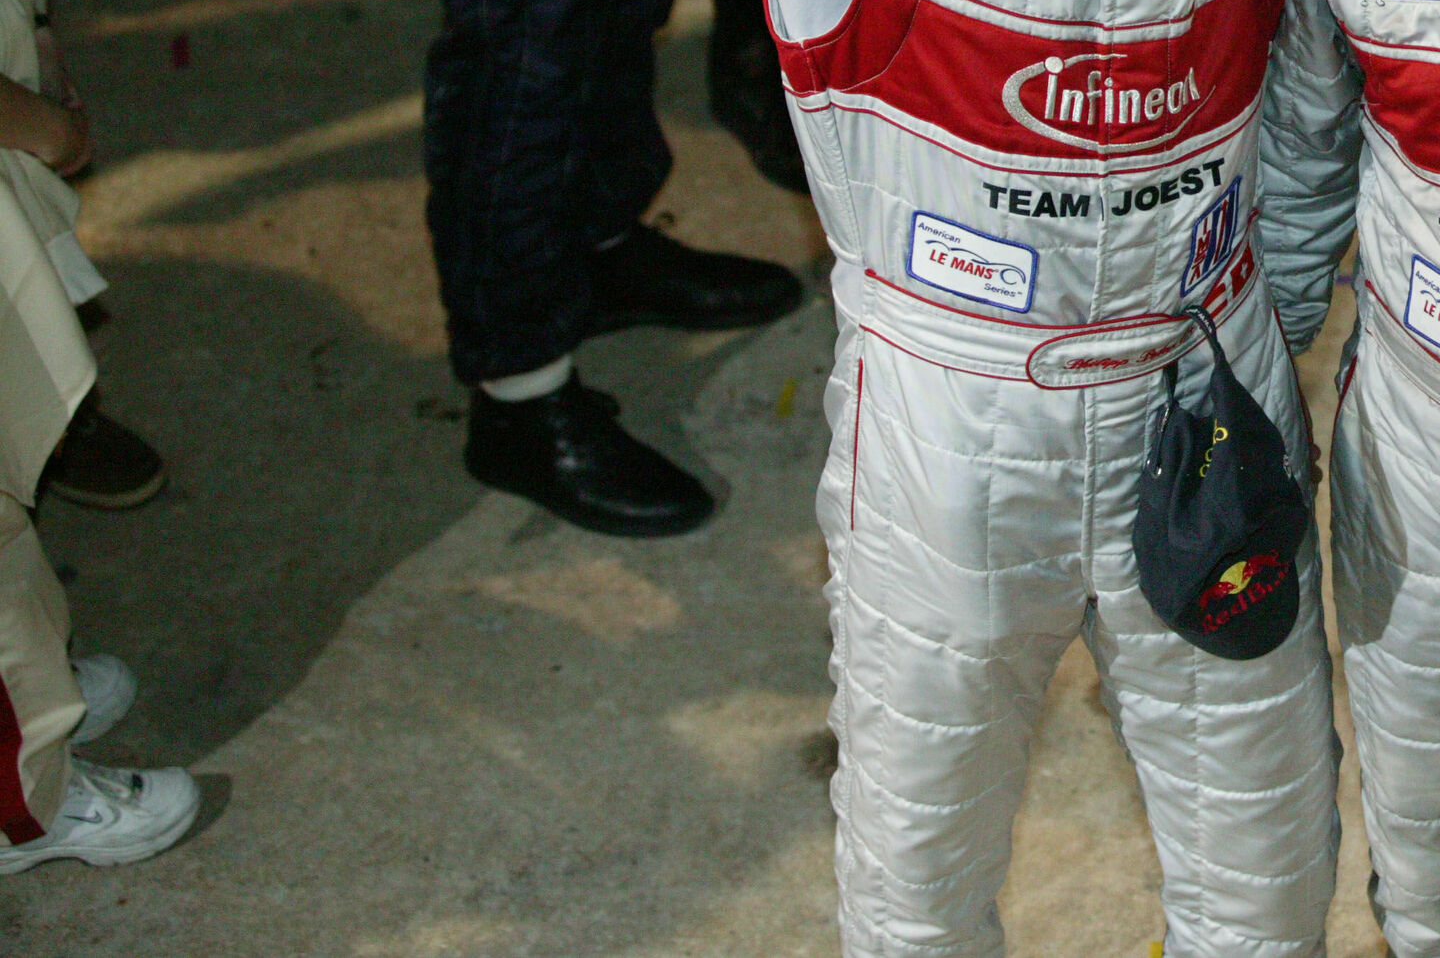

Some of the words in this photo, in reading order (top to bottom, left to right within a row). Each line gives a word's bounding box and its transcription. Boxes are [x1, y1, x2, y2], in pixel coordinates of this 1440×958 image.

[982, 182, 1091, 218] TEAM
[1111, 158, 1225, 217] JOEST
[918, 222, 961, 244] American
[929, 249, 948, 266] LE
[950, 257, 995, 280] MANS
[983, 283, 1016, 298] Series
[1423, 300, 1437, 318] LE
